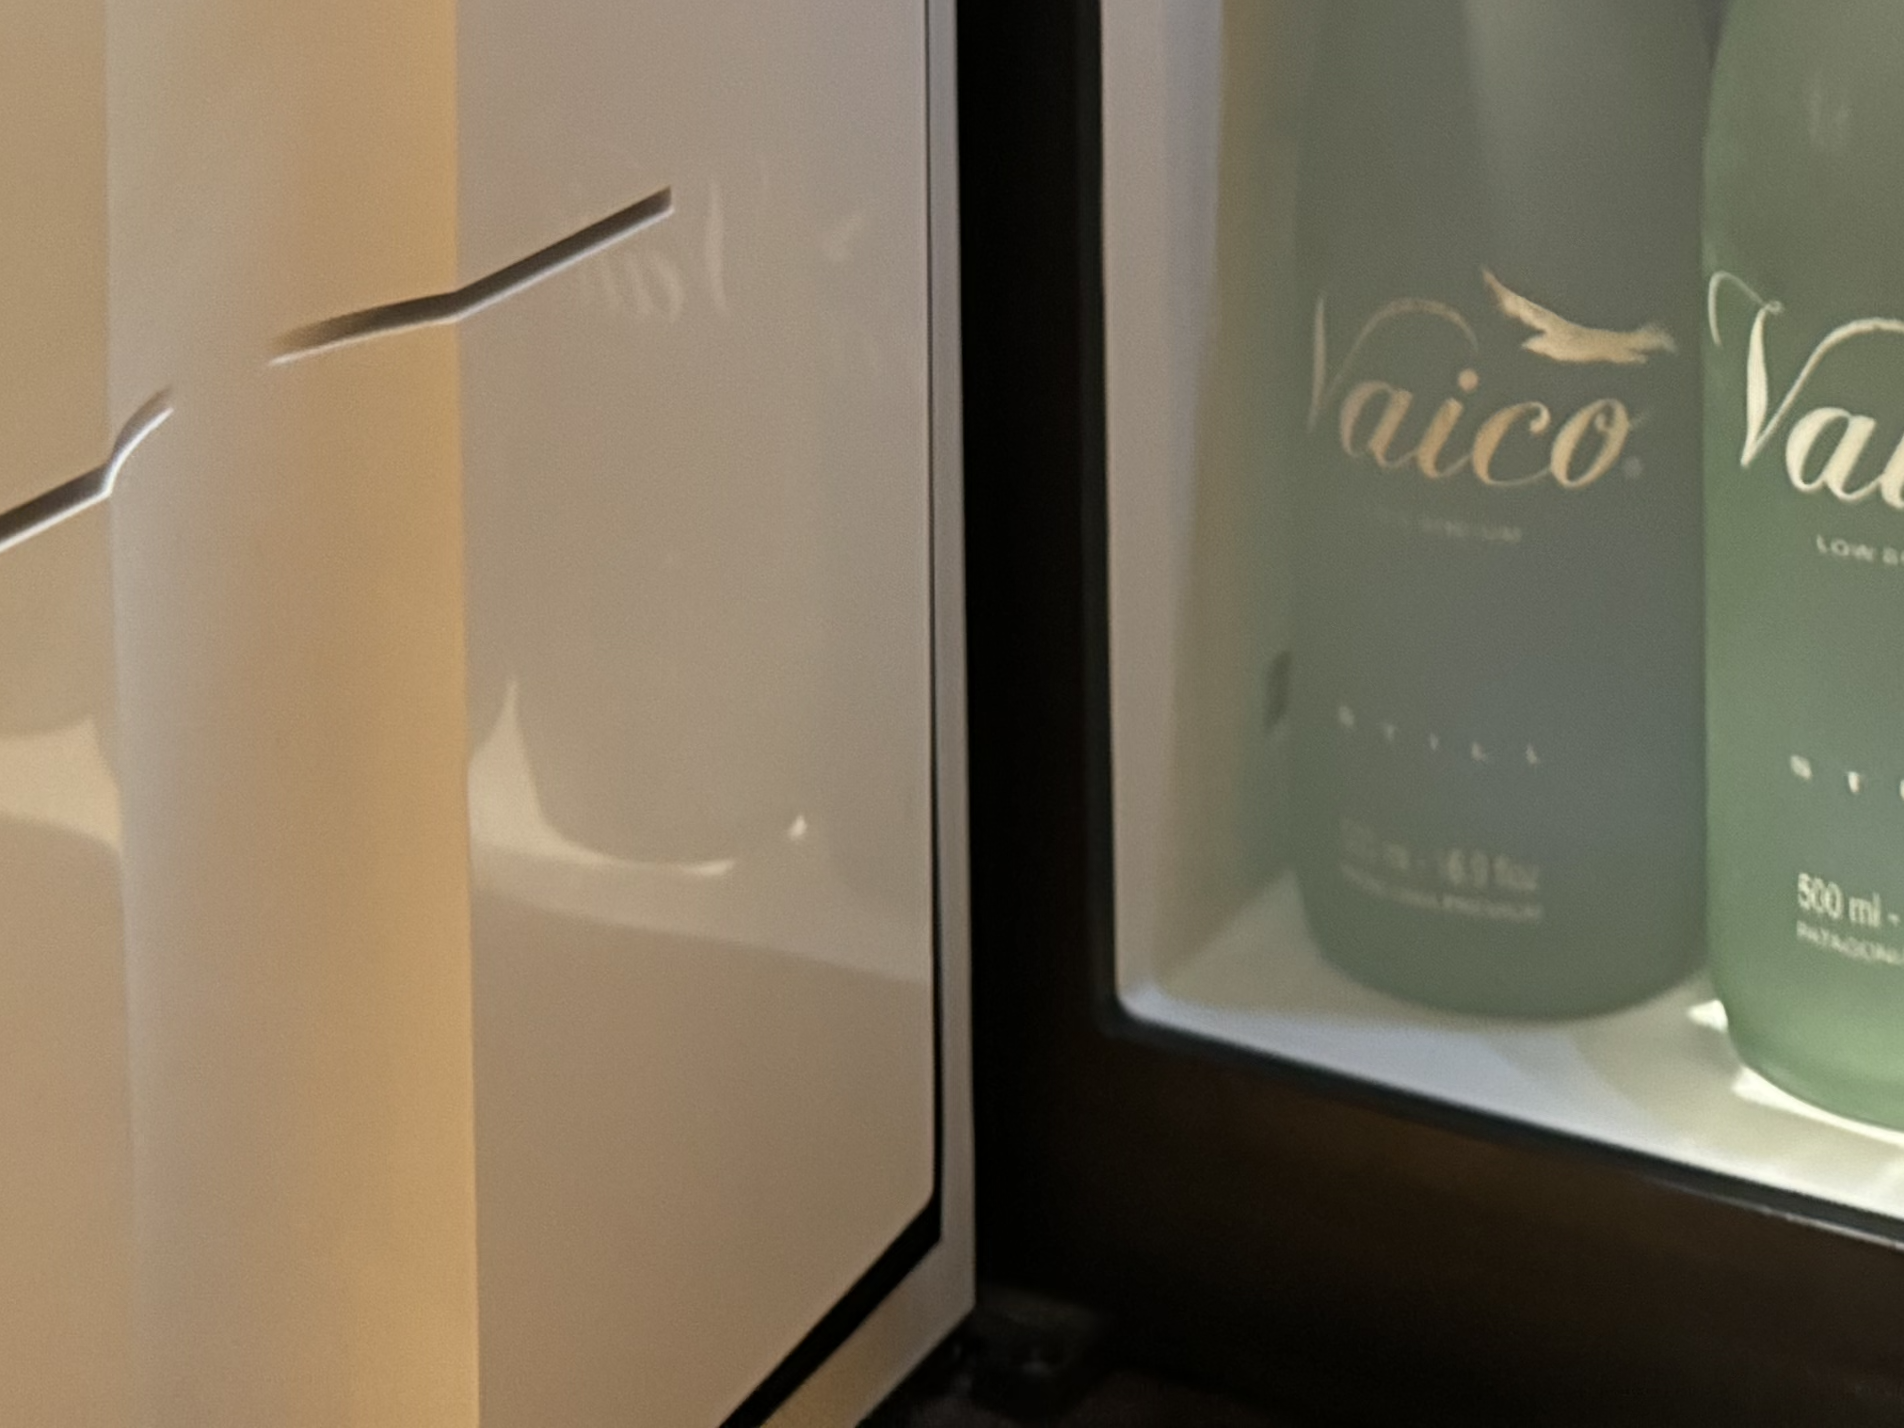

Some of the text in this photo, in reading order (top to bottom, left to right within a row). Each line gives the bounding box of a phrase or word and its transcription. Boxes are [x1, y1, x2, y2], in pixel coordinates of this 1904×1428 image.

[1306, 291, 1644, 490] Vaico
[1815, 534, 1876, 564] LOW
[1797, 872, 1845, 921] 500
[1848, 892, 1882, 929] ml
